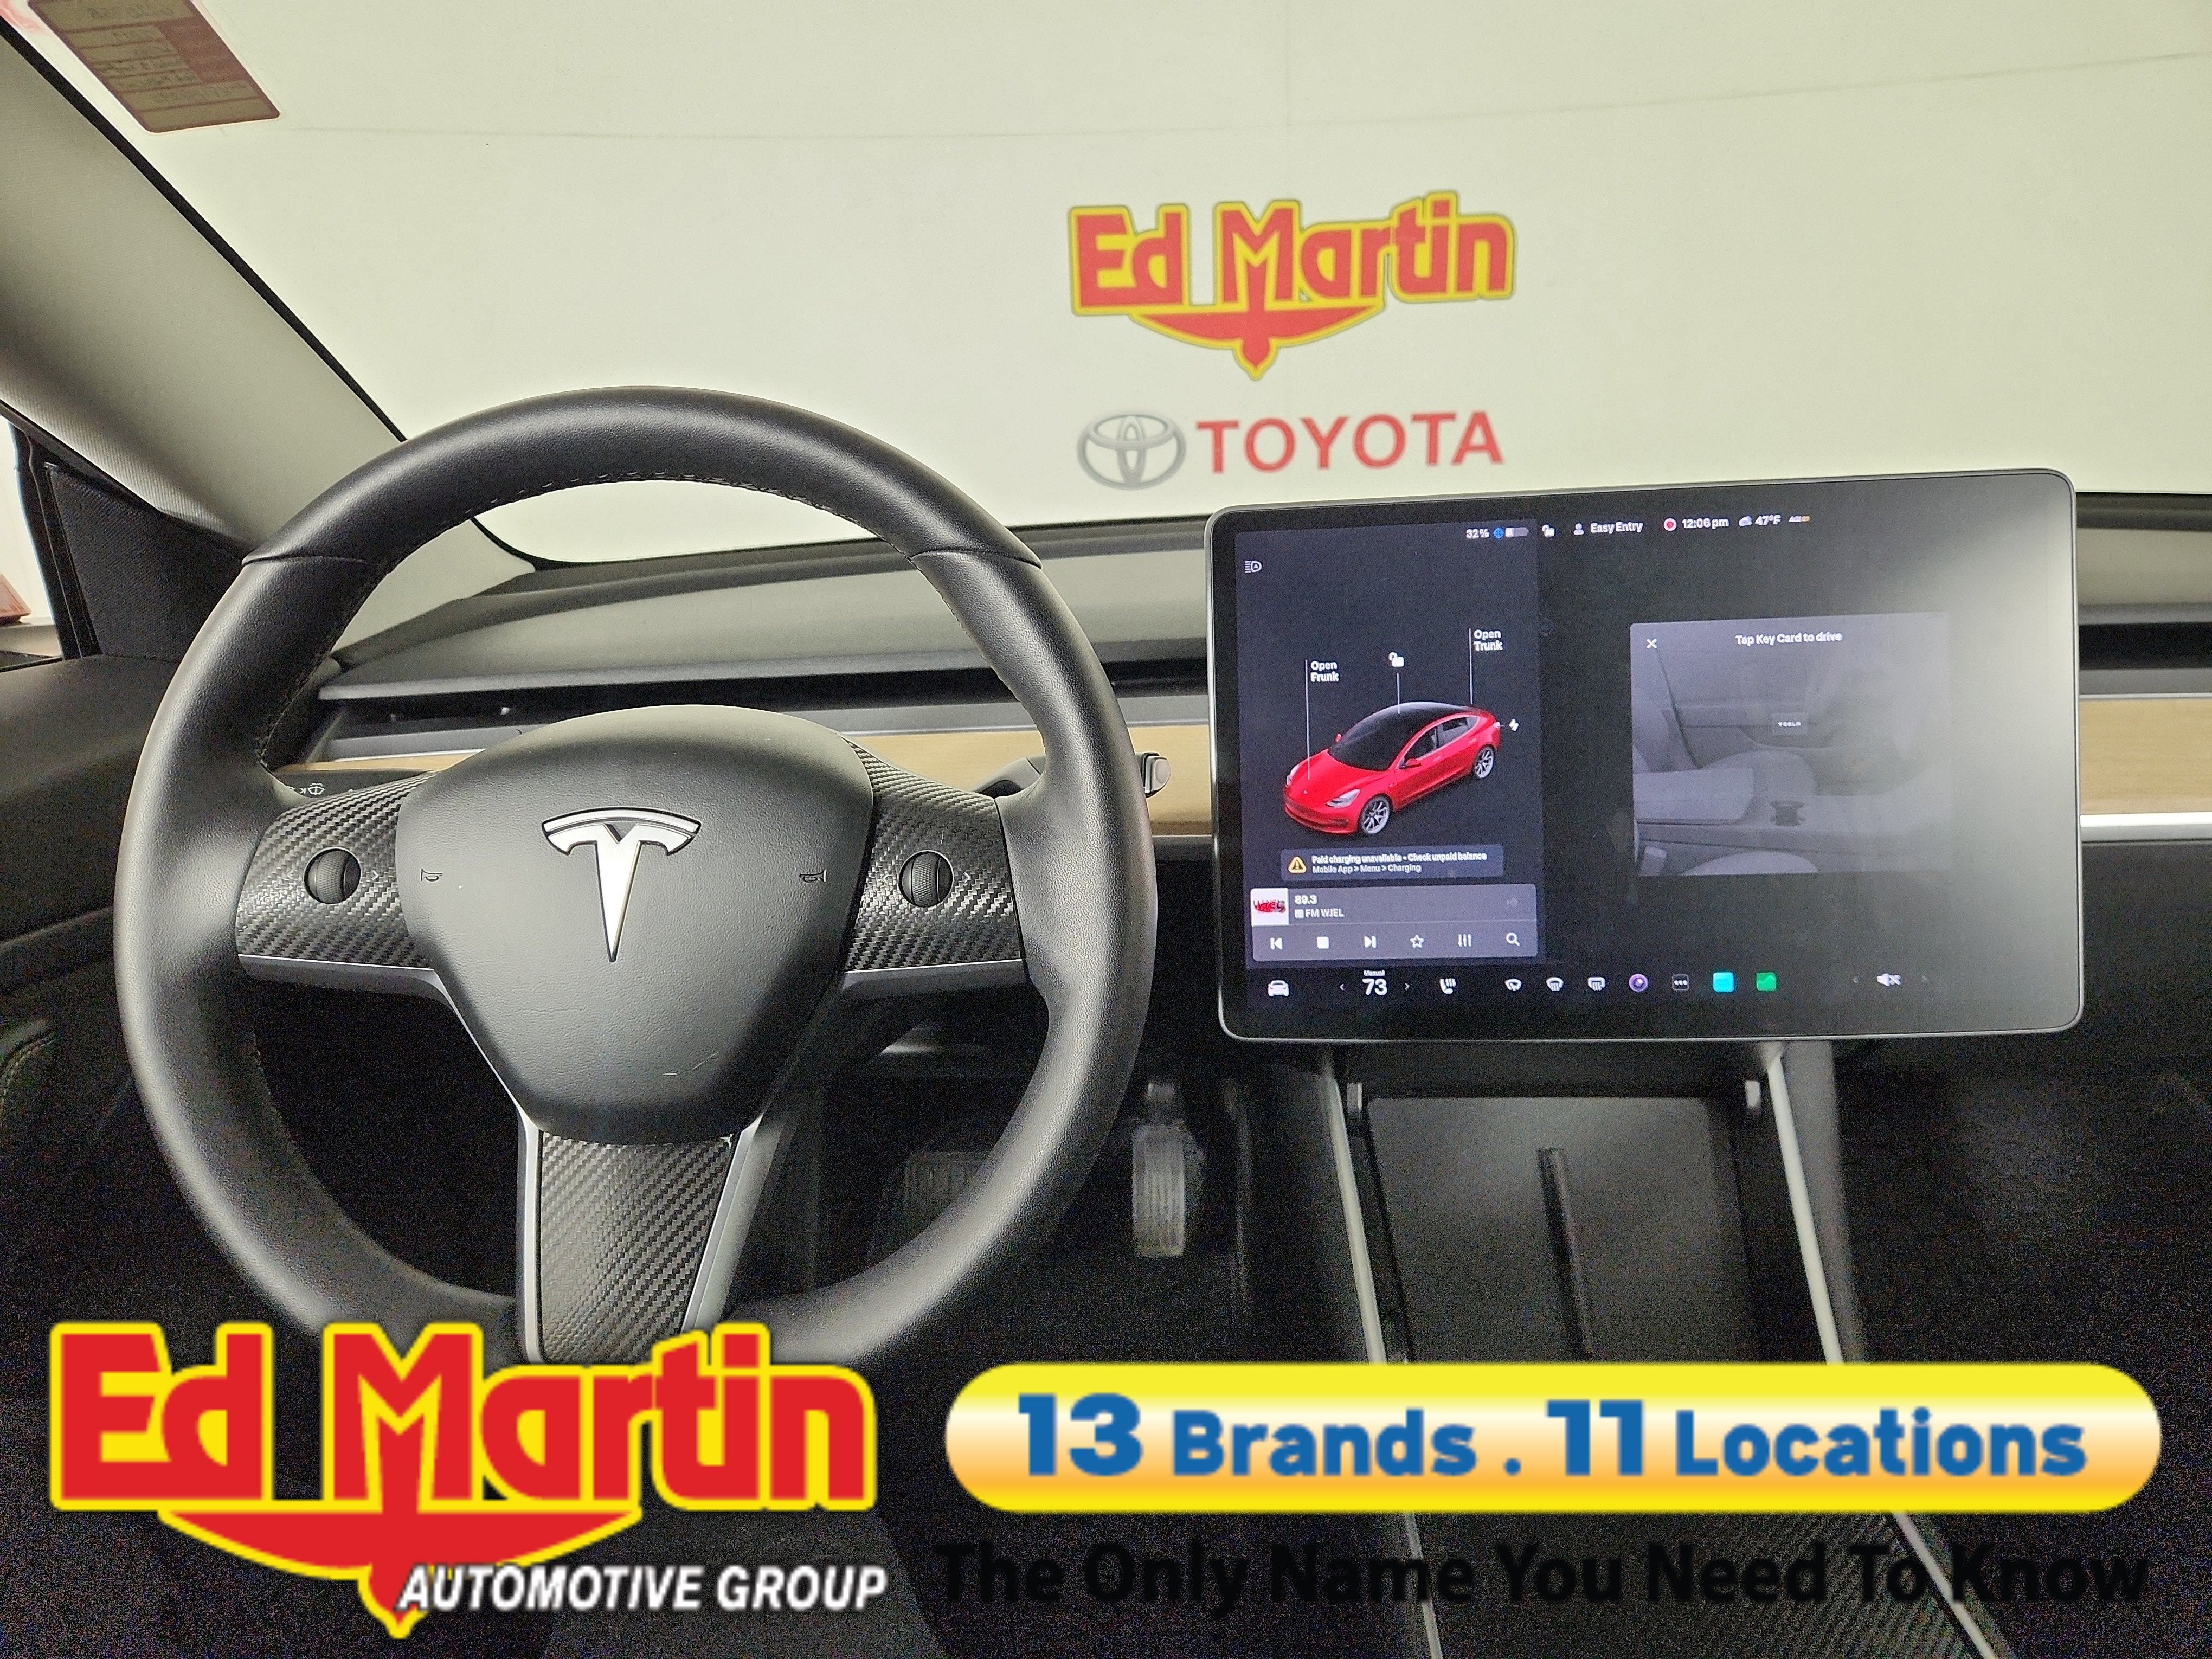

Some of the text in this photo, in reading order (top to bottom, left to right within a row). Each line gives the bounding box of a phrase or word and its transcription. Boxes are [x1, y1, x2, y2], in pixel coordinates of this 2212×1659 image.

[1073, 196, 1511, 312] Ed Martin
[1196, 411, 1504, 474] TOYOTA
[1682, 518, 1729, 529] 12:06 pm
[1755, 515, 1782, 525] 47°F
[1465, 528, 1490, 539] 32%
[1590, 522, 1643, 534] Easy Entry
[1473, 629, 1501, 640] Open
[1735, 631, 1843, 646] Tap Key Card to drive
[1473, 640, 1503, 651] Trunk
[1310, 660, 1338, 671] Open
[1310, 671, 1339, 682] Frunk
[1311, 855, 1328, 864] Paid
[1329, 854, 1361, 865] charging
[1361, 853, 1402, 863] unavailable
[1407, 853, 1432, 862] Check
[1432, 852, 1457, 863] unpaid
[1458, 852, 1487, 860] balance
[1313, 865, 1337, 873] Mobile
[1338, 865, 1353, 874] App
[1388, 864, 1422, 873] Charging
[1295, 895, 1317, 905] 89.3
[1306, 908, 1345, 918] FM WJEL
[1362, 978, 1387, 995] 73
